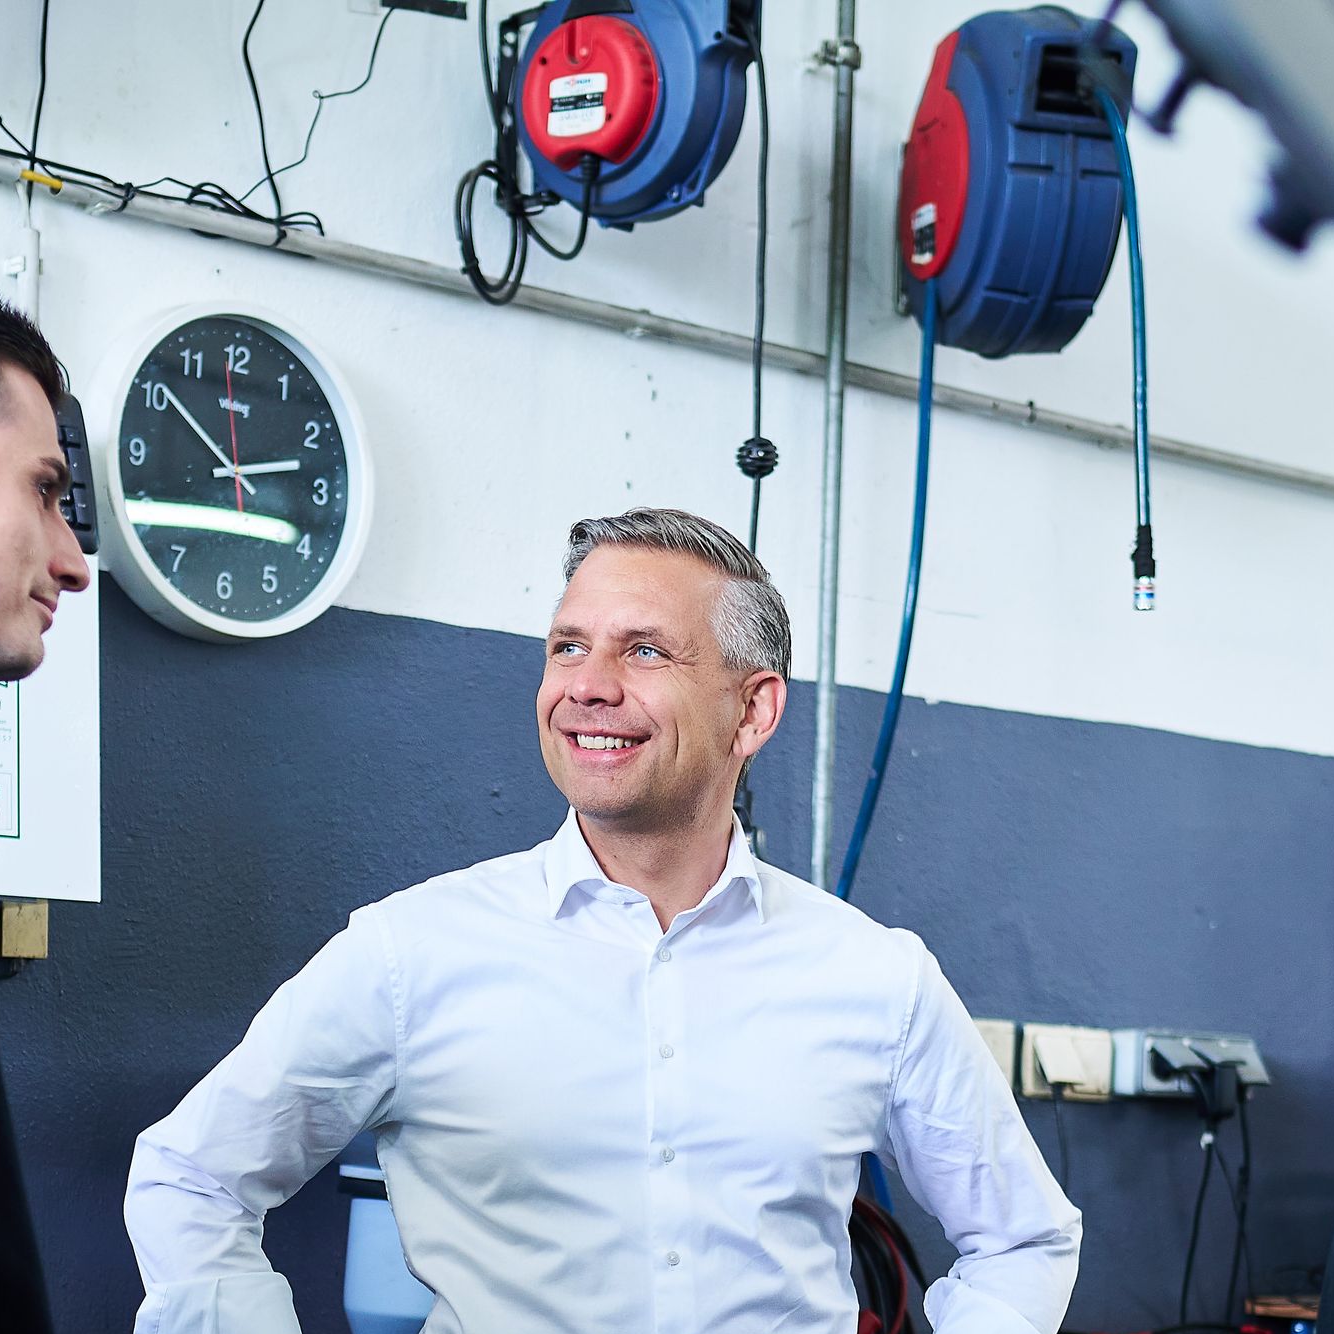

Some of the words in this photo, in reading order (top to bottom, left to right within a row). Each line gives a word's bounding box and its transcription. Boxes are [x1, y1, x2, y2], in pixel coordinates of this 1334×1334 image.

[180, 347, 204, 379] 11
[224, 343, 252, 375] 12
[141, 380, 168, 412] 10
[278, 374, 290, 401] 1
[303, 420, 322, 449] 2
[128, 438, 146, 466] 9
[312, 478, 329, 506] 3
[171, 544, 187, 573] 7
[296, 533, 311, 561] 4
[216, 572, 233, 600] 6
[261, 565, 278, 594] 5
